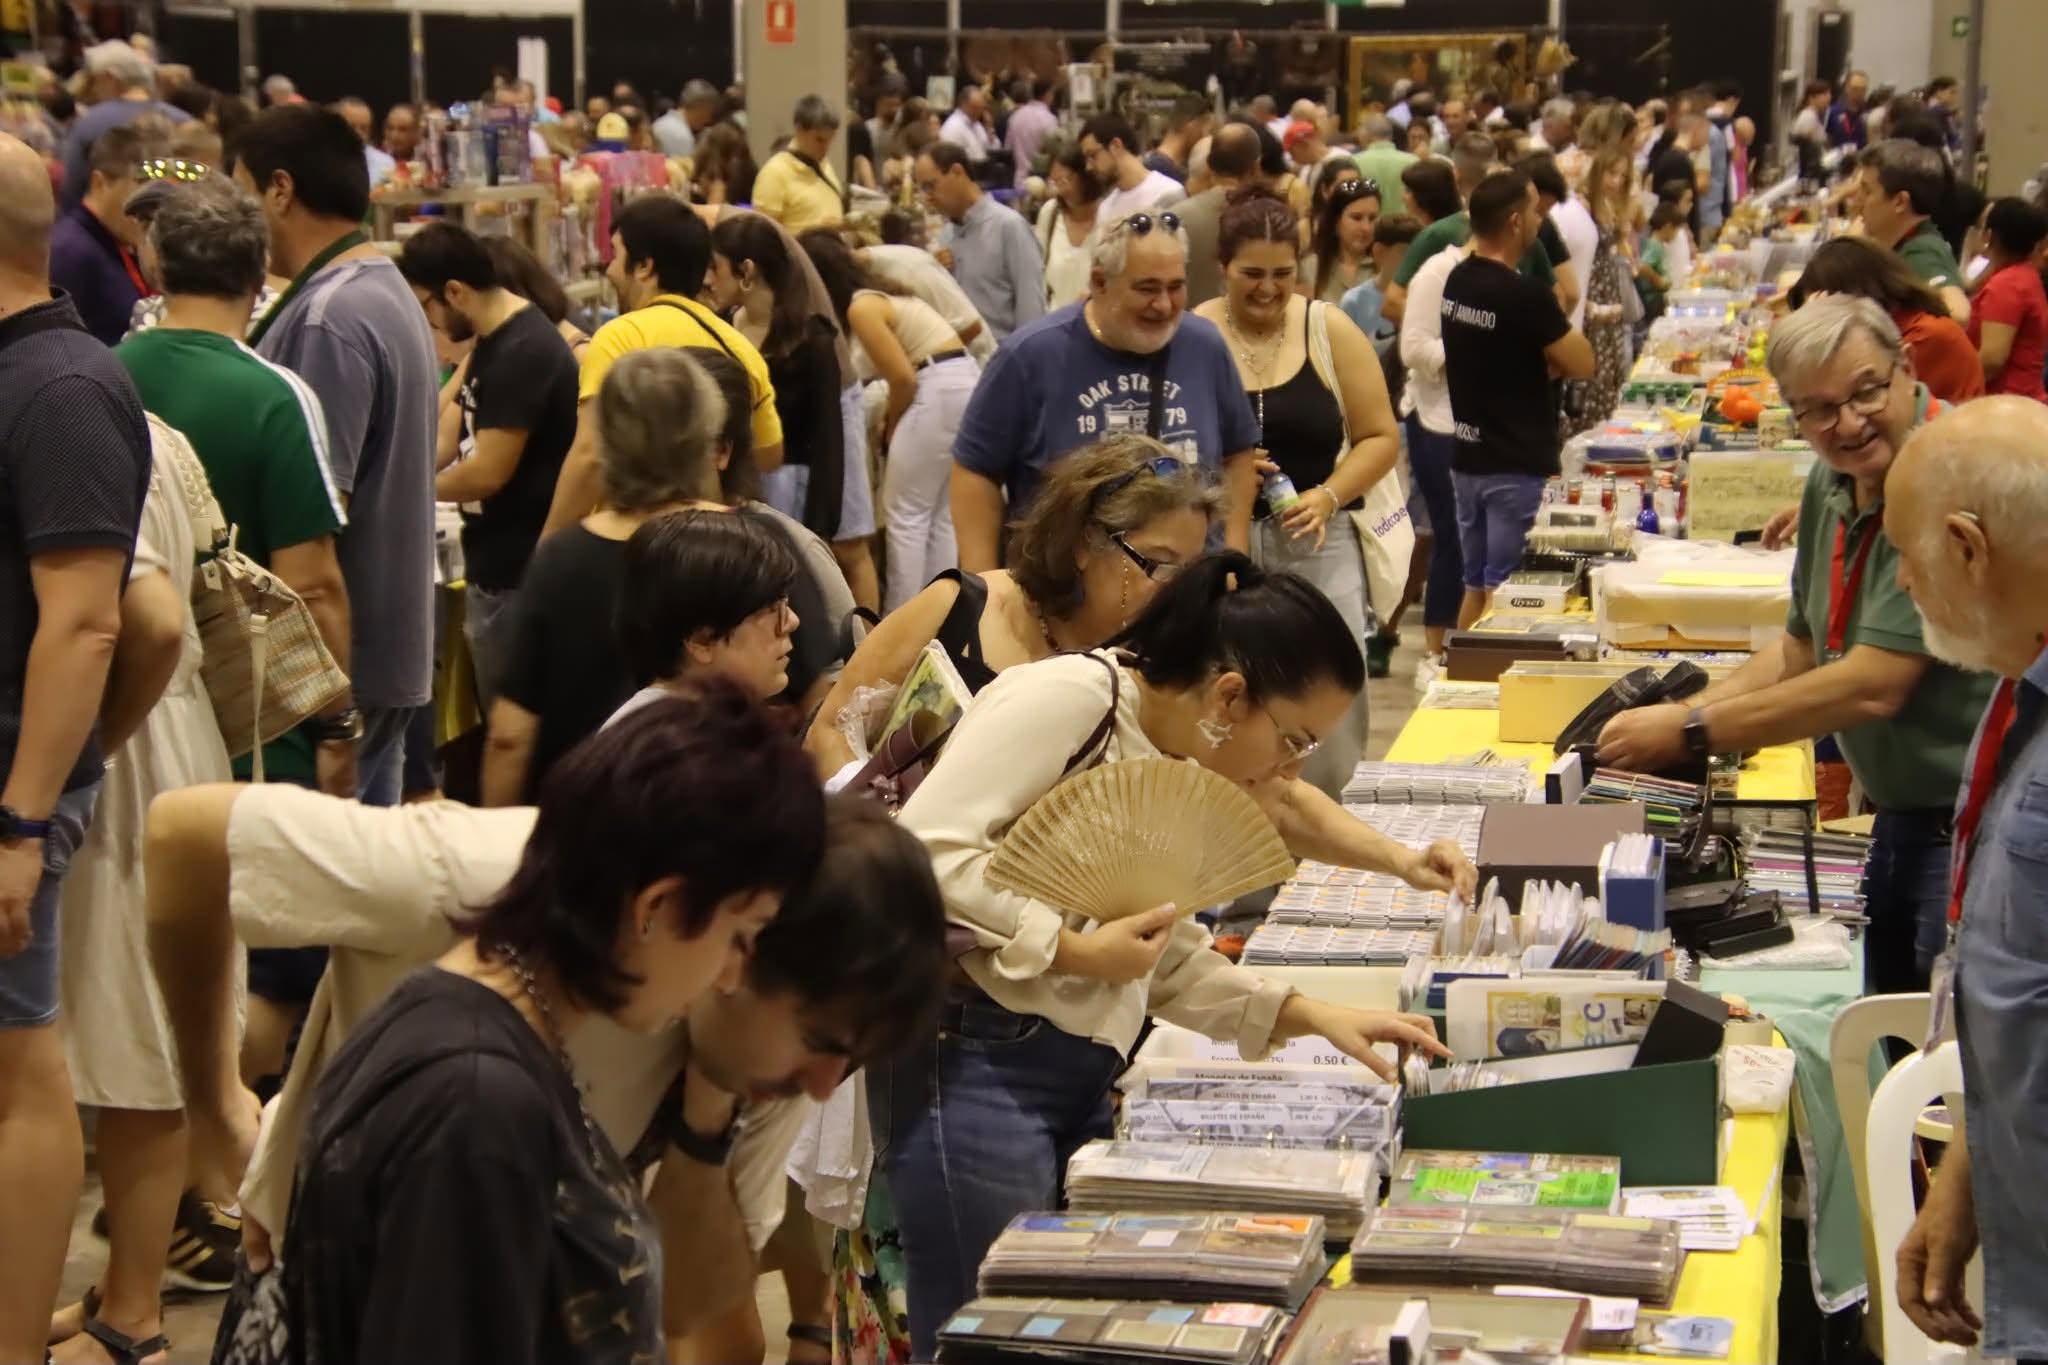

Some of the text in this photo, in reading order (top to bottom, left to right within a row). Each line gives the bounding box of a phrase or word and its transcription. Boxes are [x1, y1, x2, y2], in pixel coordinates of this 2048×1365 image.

[1078, 373, 1181, 409] OAK STRET
[1077, 407, 1187, 433] 19 79
[1313, 1055, 1338, 1065] 0.50
[1341, 1055, 1349, 1065] €
